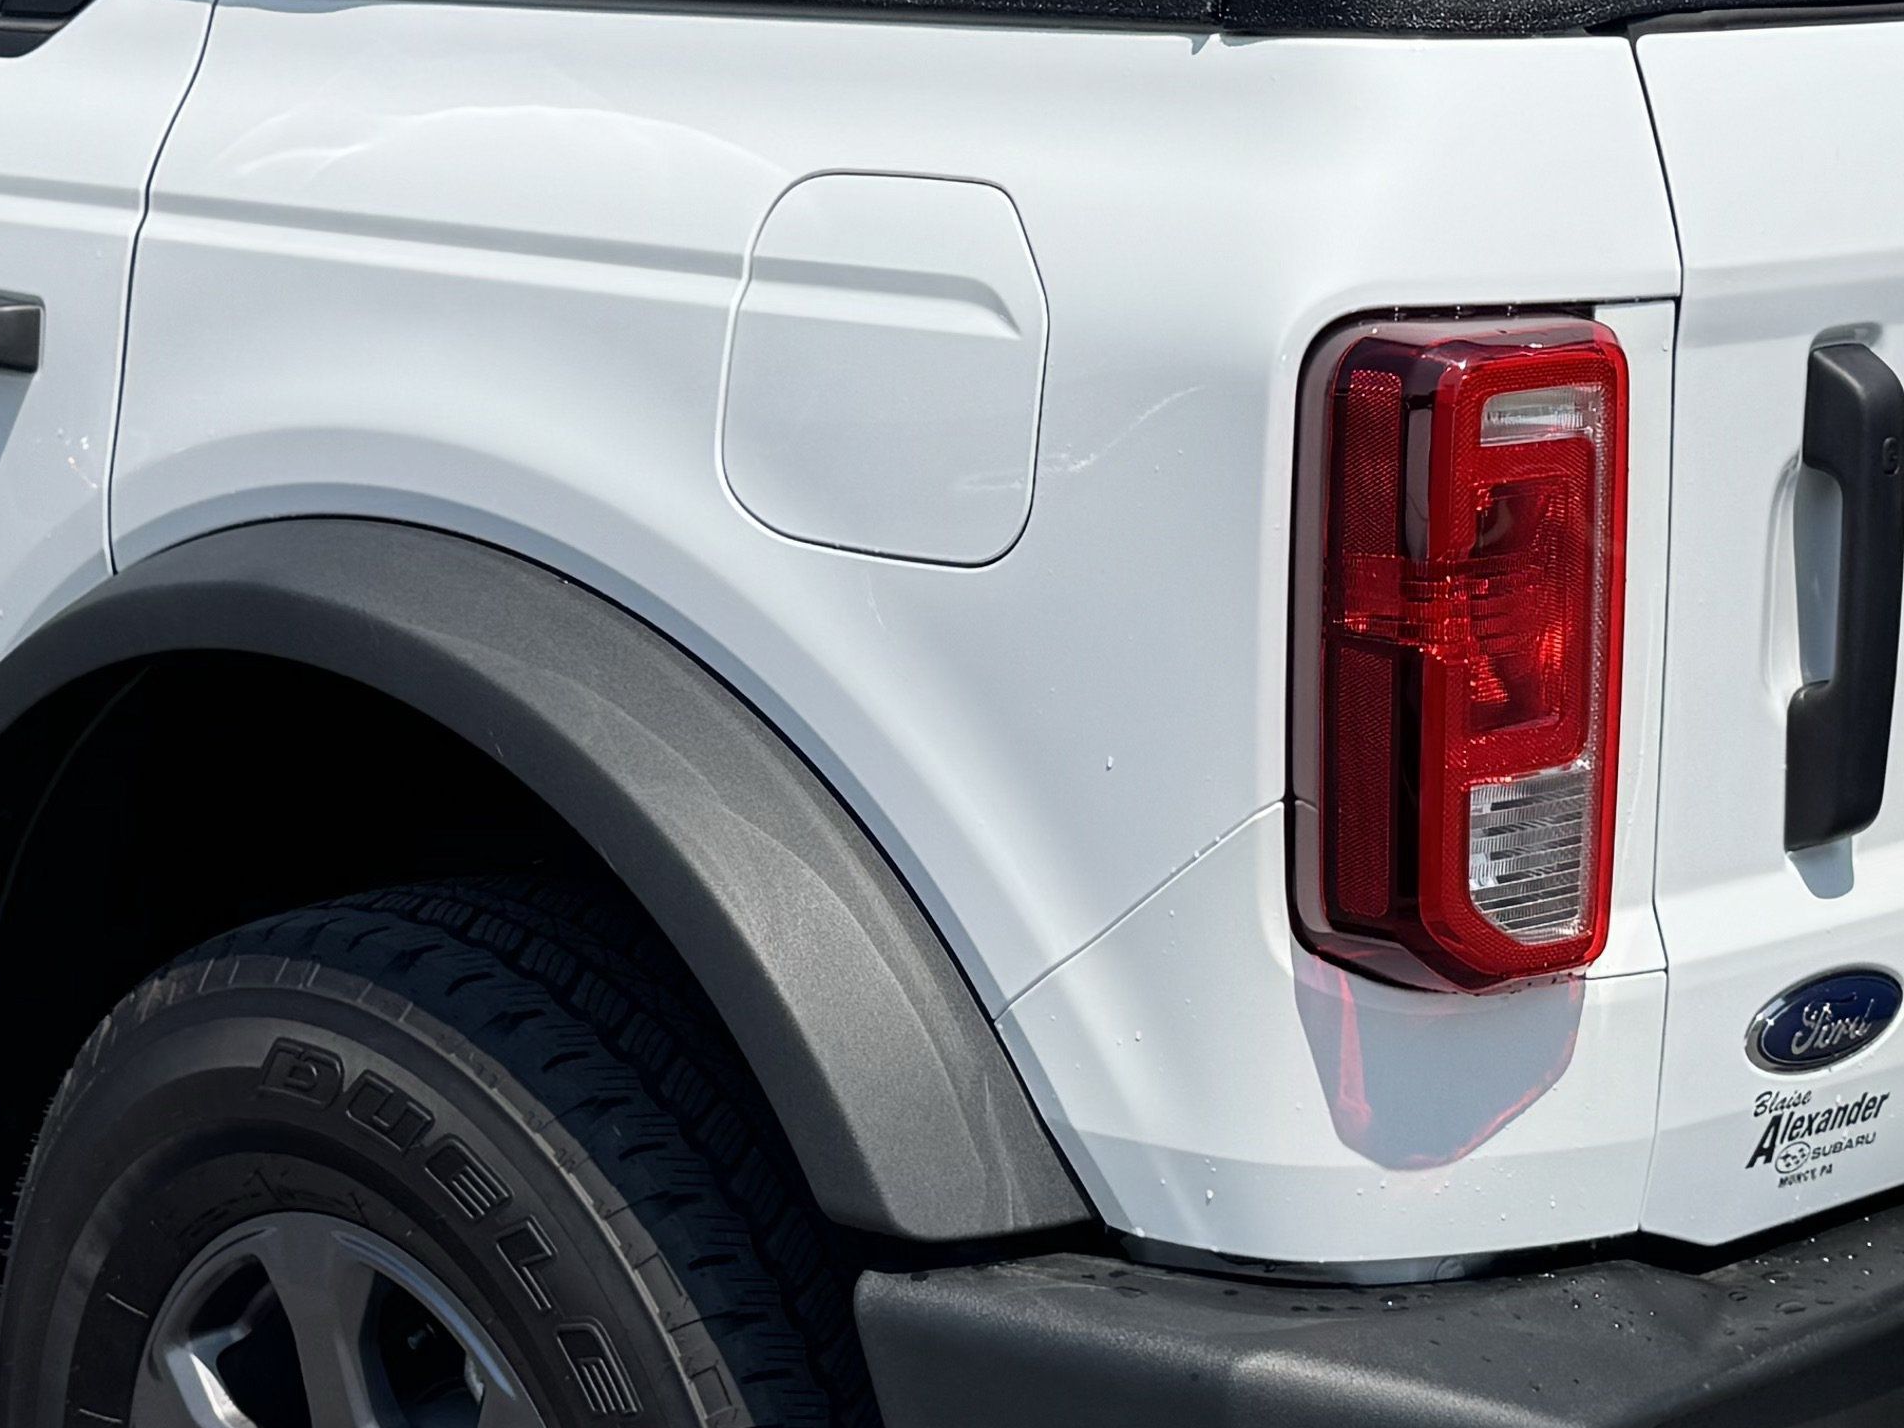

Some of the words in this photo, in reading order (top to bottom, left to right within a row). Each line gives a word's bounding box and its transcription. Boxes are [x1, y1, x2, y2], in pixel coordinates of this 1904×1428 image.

[1790, 990, 1874, 1055] Ford
[1753, 1090, 1812, 1117] Blaise
[1745, 1091, 1890, 1169] Alexander
[1811, 1131, 1876, 1160] SUBARU
